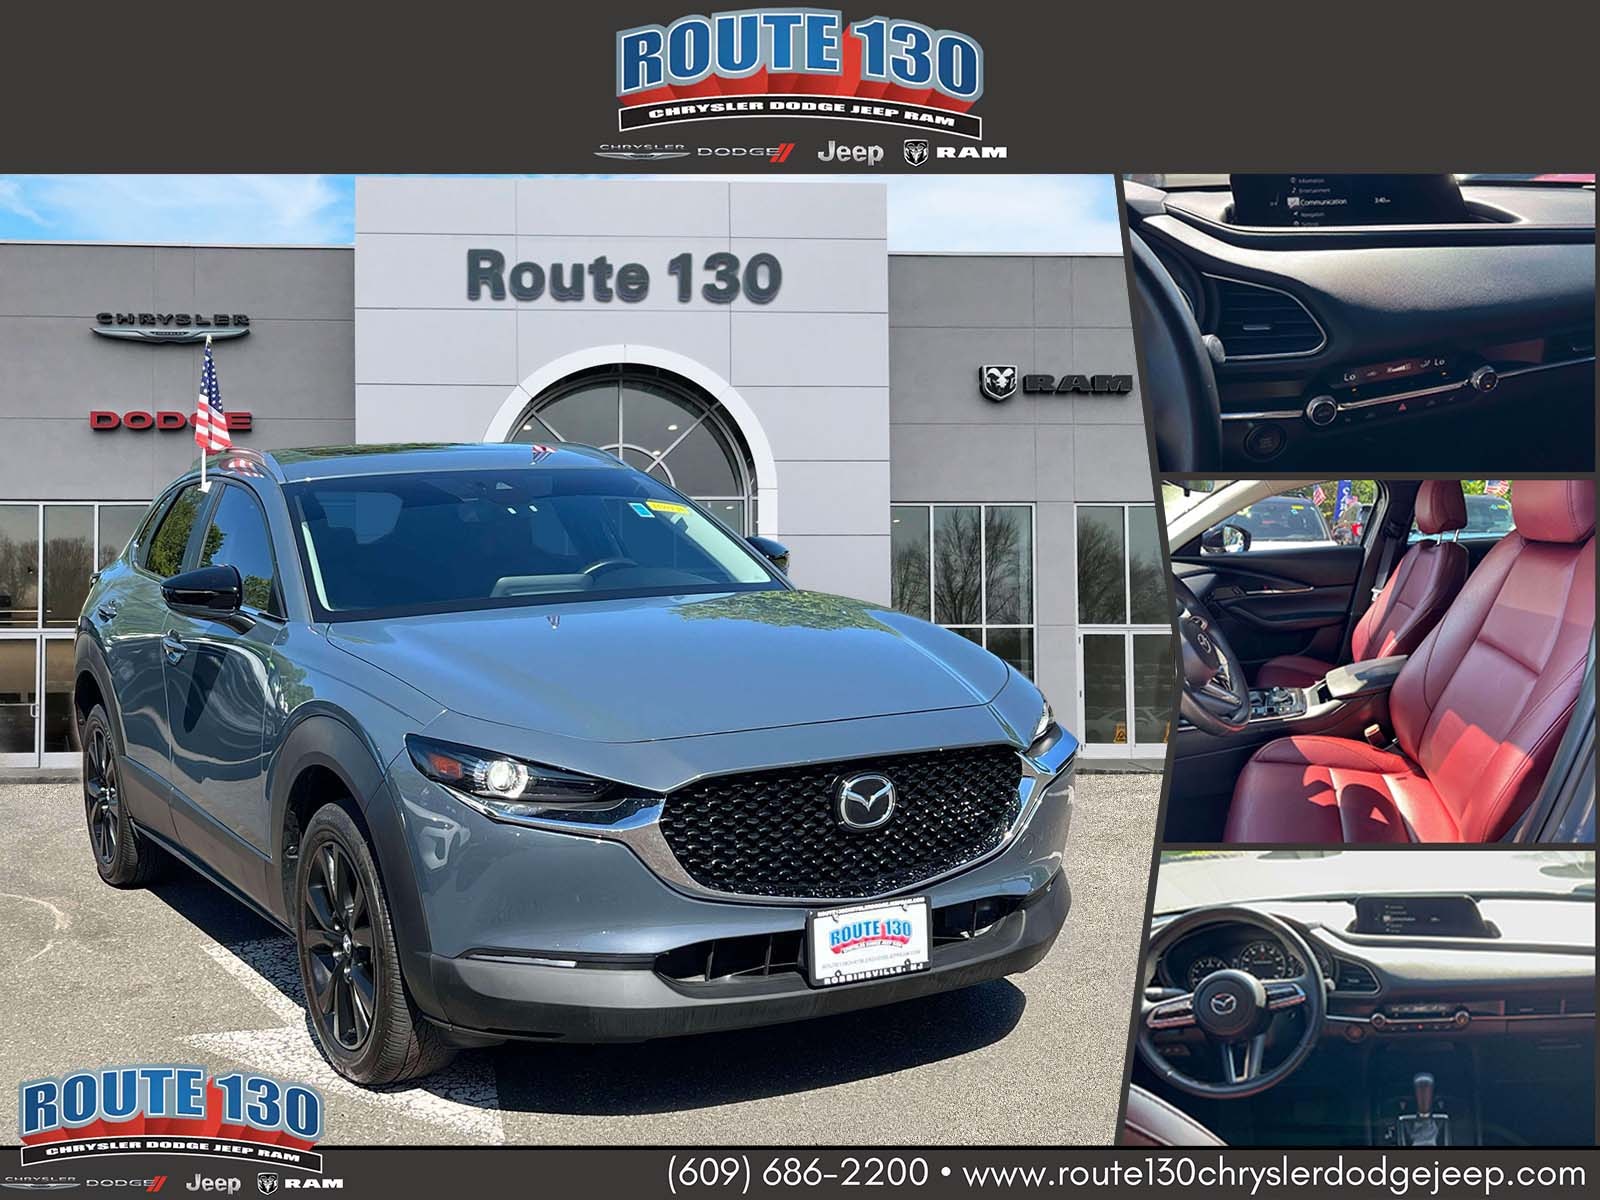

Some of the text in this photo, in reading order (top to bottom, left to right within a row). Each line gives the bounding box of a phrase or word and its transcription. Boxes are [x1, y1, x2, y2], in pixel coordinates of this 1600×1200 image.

[466, 248, 783, 305] Route 130
[96, 312, 250, 326] CHRYSLER
[1023, 374, 1133, 395] RAM
[89, 410, 252, 432] DODE
[830, 919, 912, 946] ROUTE 130
